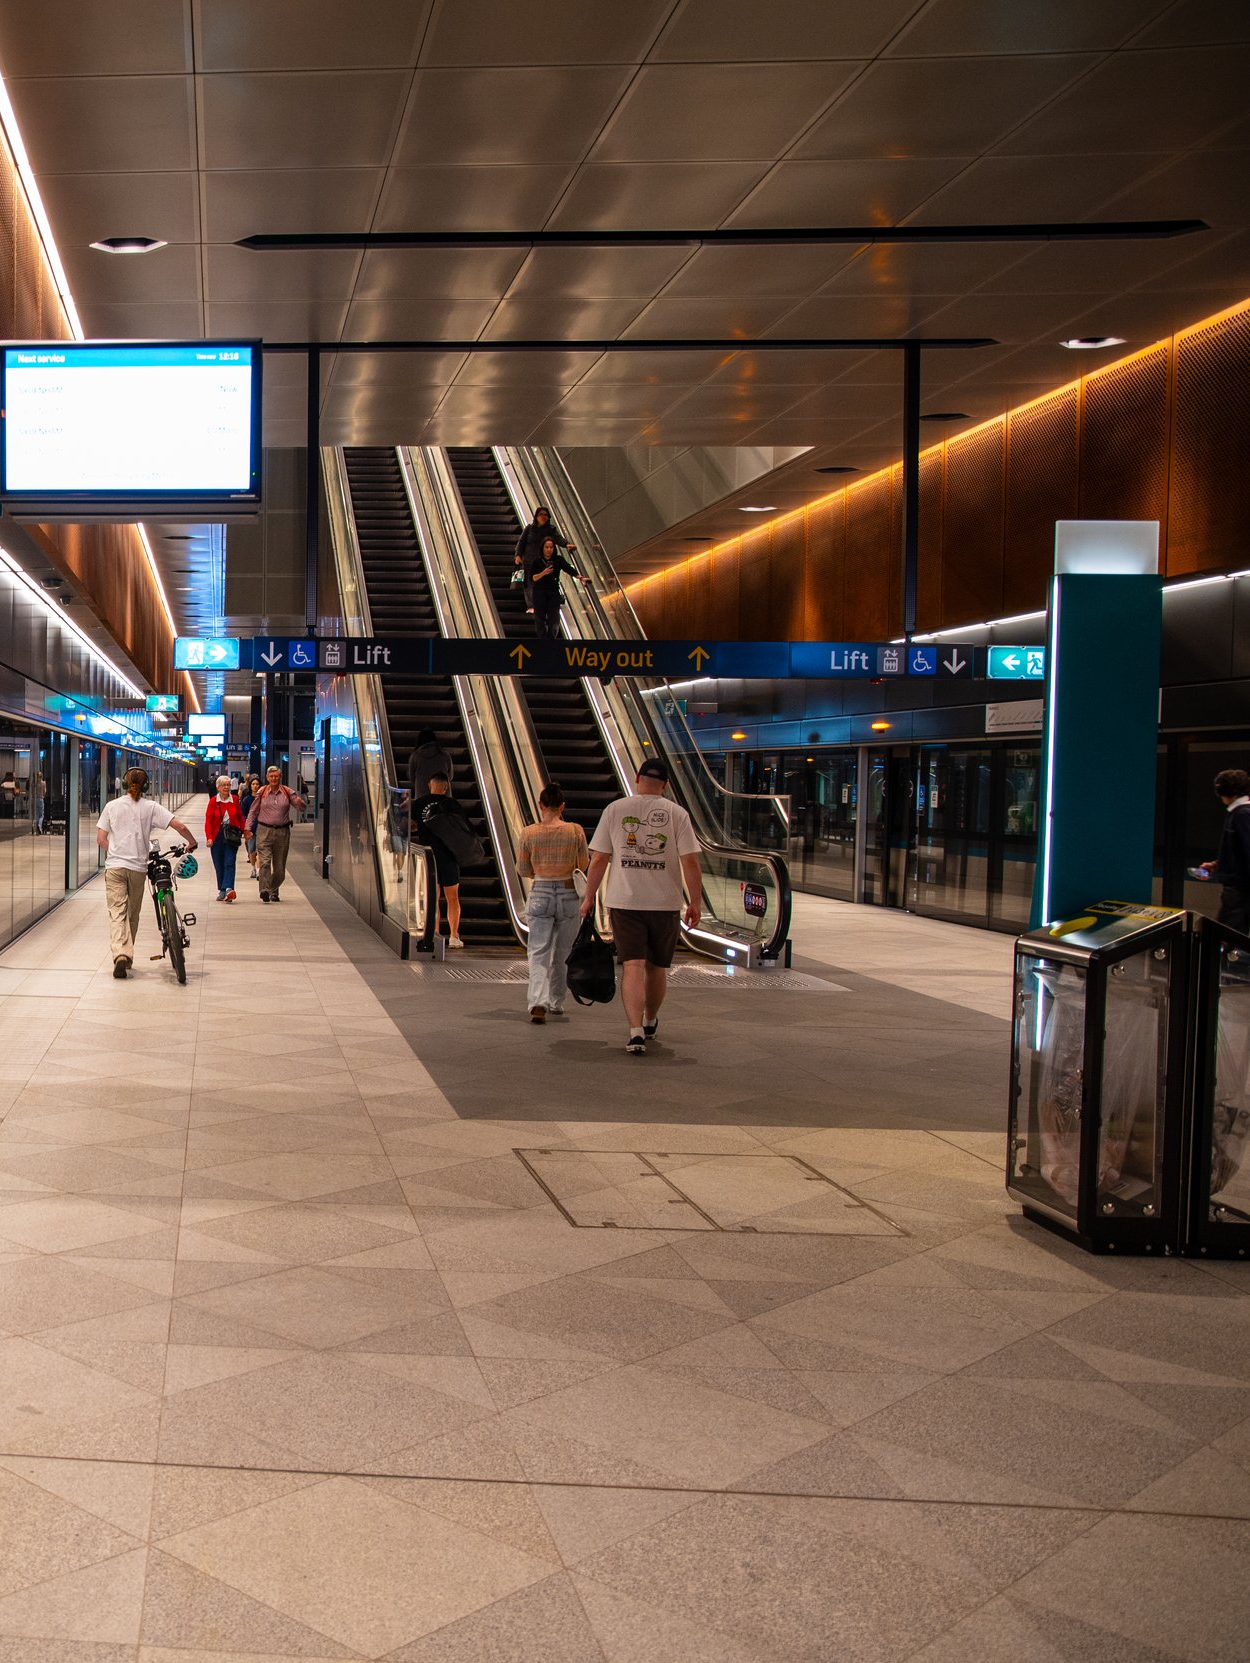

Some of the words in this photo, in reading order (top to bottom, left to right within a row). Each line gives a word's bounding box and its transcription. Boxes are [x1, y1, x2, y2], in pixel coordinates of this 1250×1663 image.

[17, 354, 36, 363] Next
[37, 354, 65, 363] service
[354, 645, 391, 664] Lift
[565, 647, 611, 671] Way
[616, 650, 654, 667] out
[830, 650, 869, 670] Lift
[621, 860, 666, 870] PEANUTS
